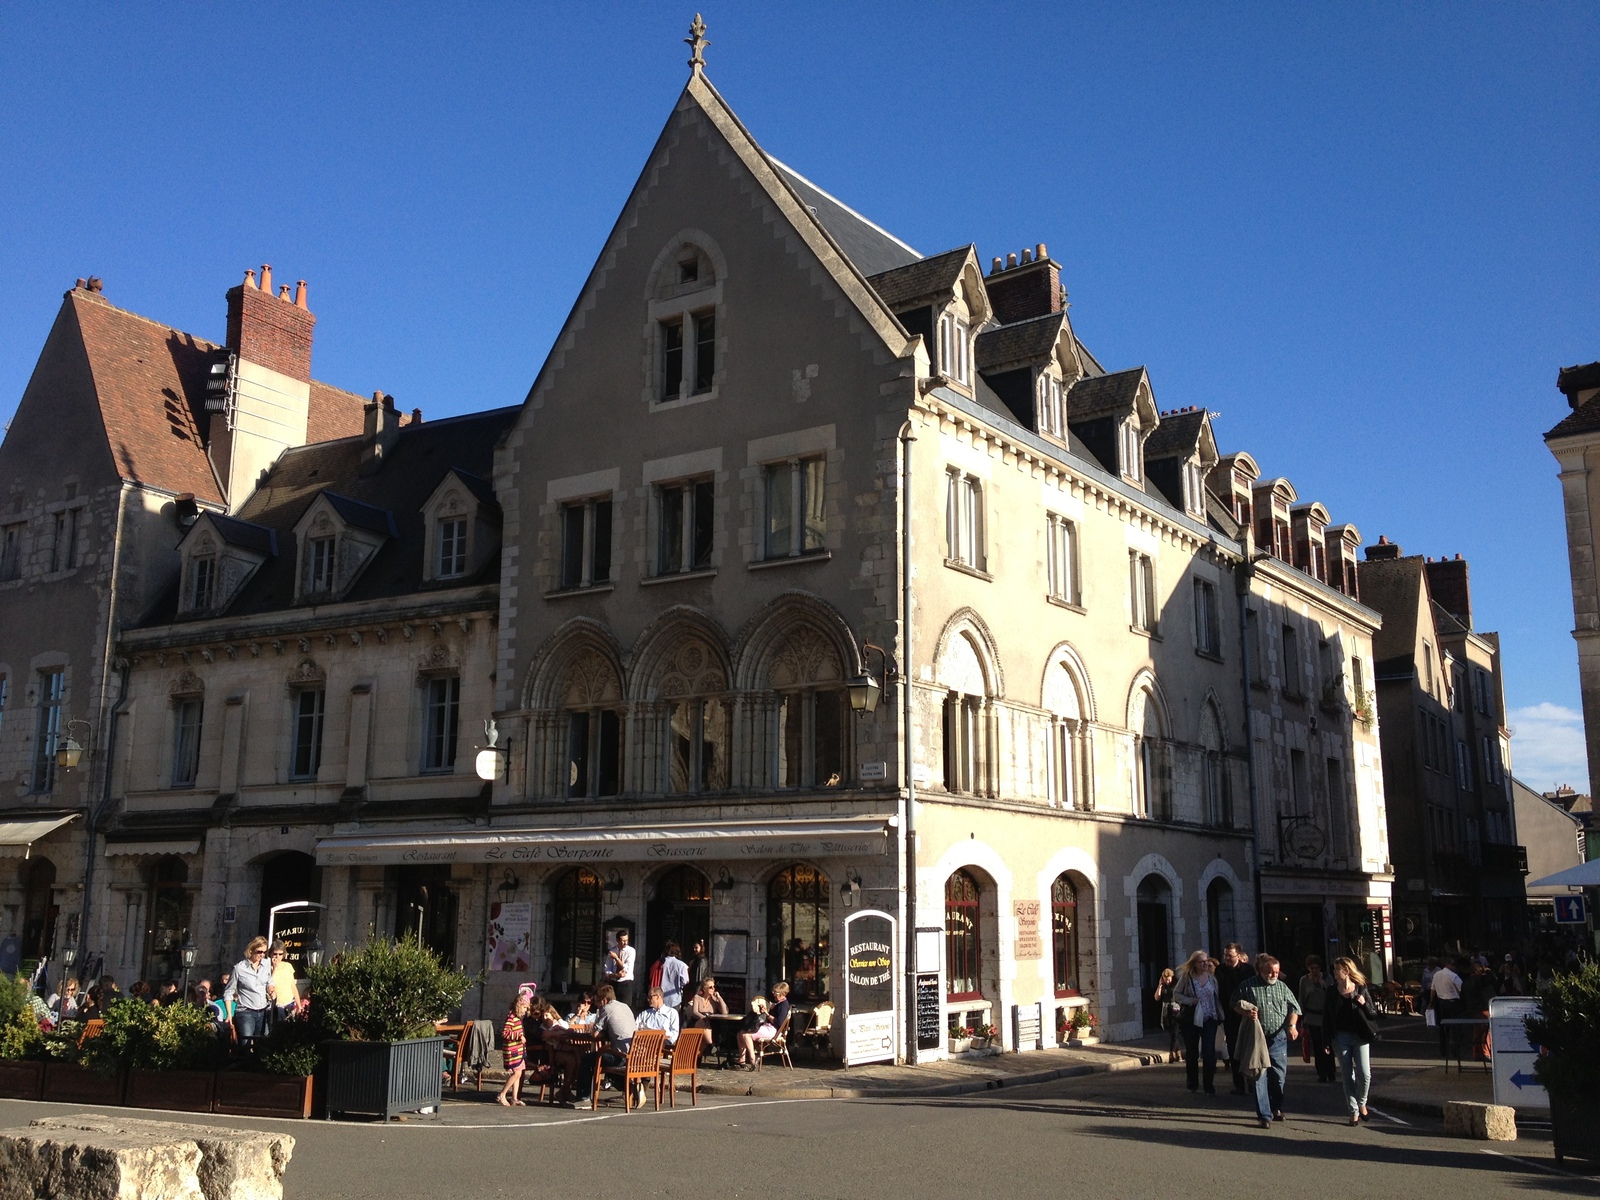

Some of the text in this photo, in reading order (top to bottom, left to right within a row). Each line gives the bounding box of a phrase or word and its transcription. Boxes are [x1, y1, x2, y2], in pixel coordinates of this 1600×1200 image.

[402, 849, 457, 861] Restaurant
[484, 846, 506, 860] Le
[512, 846, 541, 861] Café
[547, 845, 614, 860] Serpente
[646, 843, 707, 857] Brasserie
[740, 843, 773, 854] Salon
[776, 844, 786, 853] de
[945, 911, 974, 930] AURANT
[849, 941, 890, 956] RESTAURANT
[849, 958, 868, 968] Service
[877, 956, 890, 969] Stop
[849, 968, 891, 986] SALON DE THÉ
